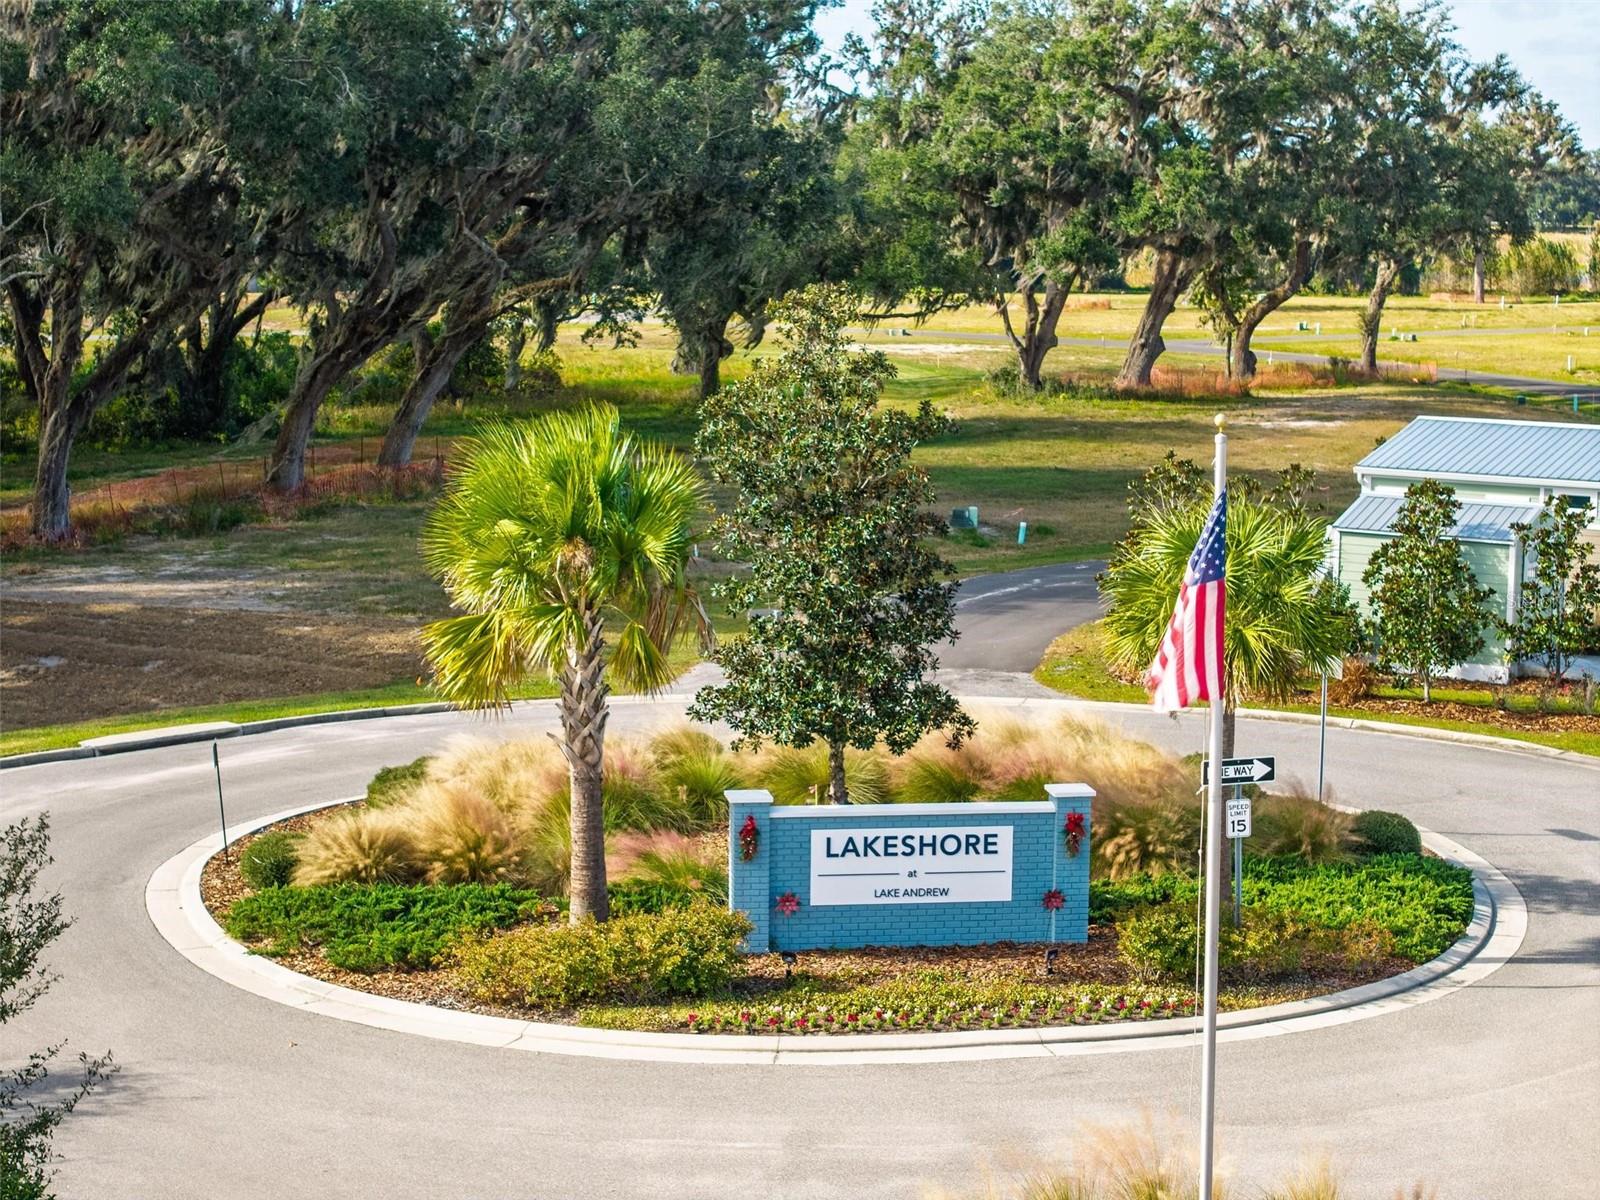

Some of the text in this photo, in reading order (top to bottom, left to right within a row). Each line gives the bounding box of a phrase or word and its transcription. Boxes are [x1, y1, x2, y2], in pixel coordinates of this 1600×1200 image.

[1233, 766, 1253, 776] WAY
[1230, 820, 1247, 832] 15
[826, 834, 998, 858] LAKESHORE
[907, 869, 917, 878] at
[874, 888, 950, 898] LAKE ANDREW
